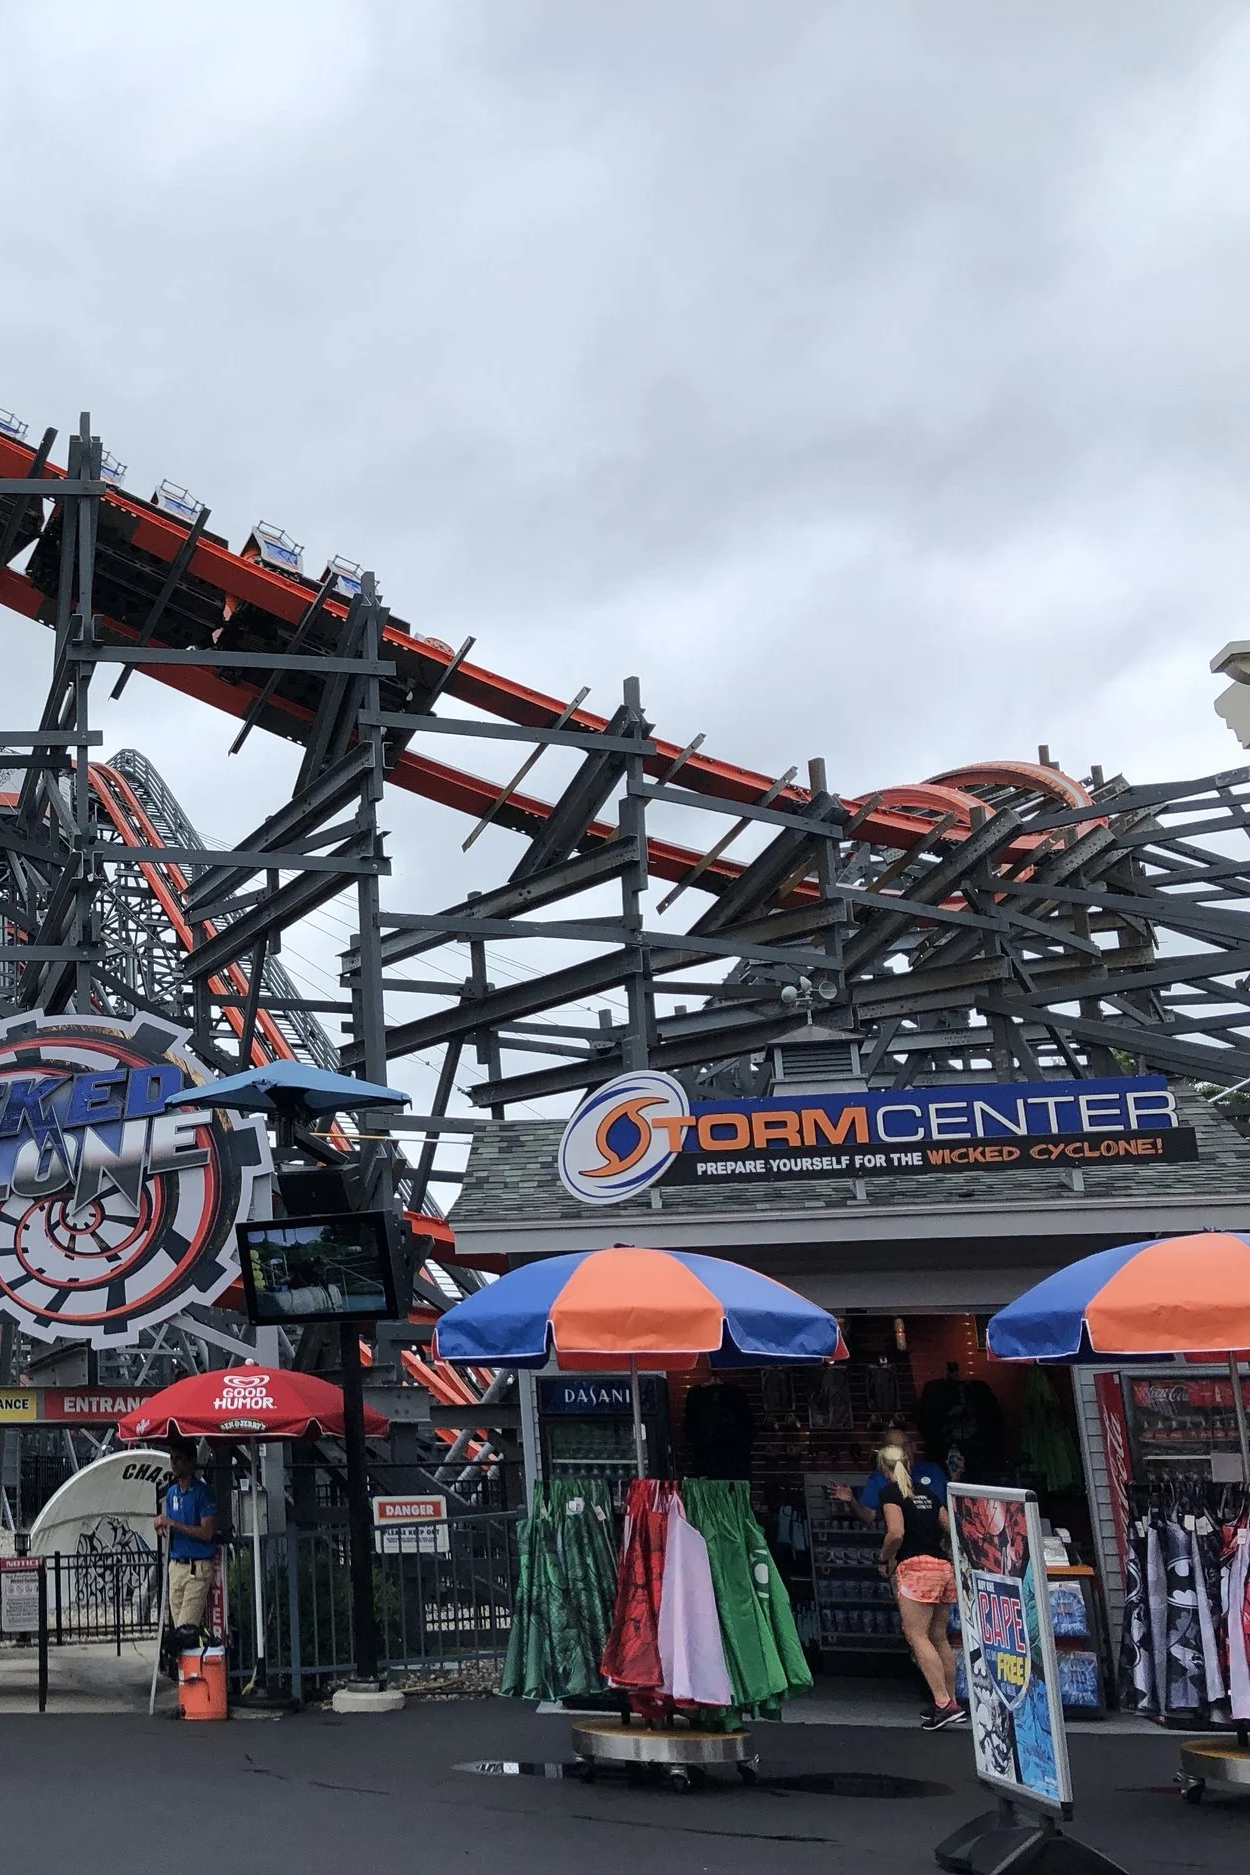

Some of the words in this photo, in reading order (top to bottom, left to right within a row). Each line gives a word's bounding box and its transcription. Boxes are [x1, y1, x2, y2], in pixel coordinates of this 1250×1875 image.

[876, 1090, 1179, 1142] CENTER
[697, 1158, 768, 1176] PREPARE
[769, 1155, 850, 1174] YOURSELF
[855, 1153, 887, 1169] FOR
[890, 1152, 923, 1167] THE
[927, 1145, 1020, 1166] WICKED
[1030, 1137, 1164, 1160] CYCLONE!
[222, 1387, 267, 1398] GOOD
[564, 1384, 630, 1406] DASANI
[64, 1396, 151, 1413] ENTRAN
[385, 1504, 435, 1516] DANGER
[979, 1591, 1027, 1654] CAPE
